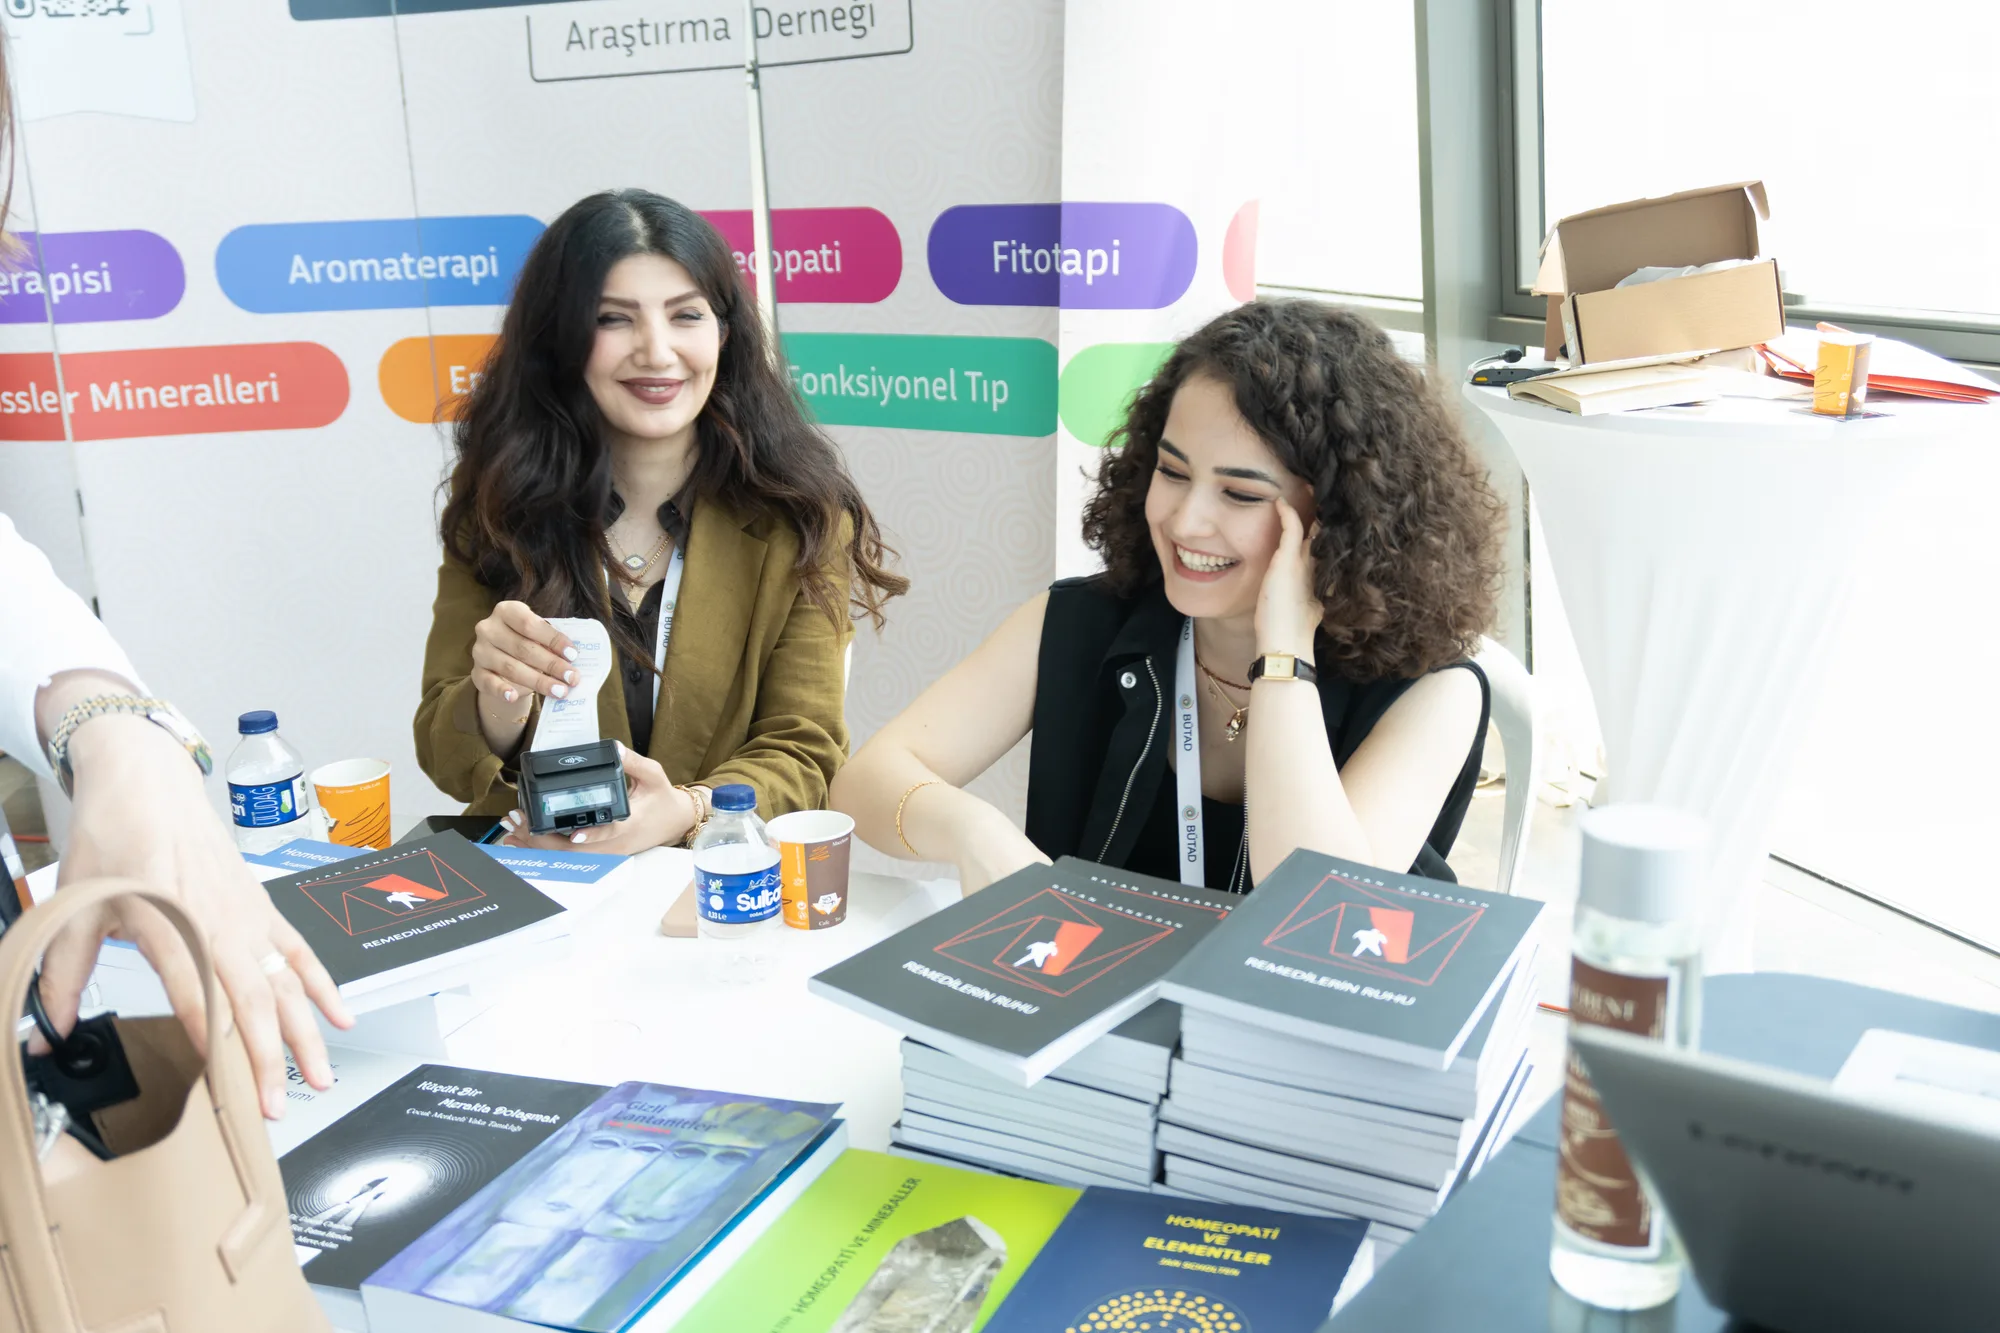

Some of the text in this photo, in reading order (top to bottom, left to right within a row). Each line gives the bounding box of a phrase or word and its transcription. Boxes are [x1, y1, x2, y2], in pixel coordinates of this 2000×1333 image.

[566, 16, 732, 57] Araştırma
[288, 246, 499, 286] Aromaterapi
[89, 372, 281, 412] Mineralleri
[964, 371, 1009, 411] Tıp
[1182, 714, 1193, 752] BÜTAD
[1186, 825, 1197, 863] BÜTAD
[548, 862, 600, 873] Sinerji
[362, 903, 500, 950] REMEDİLERİN RUHU
[992, 994, 1040, 1016] RUHU
[1360, 986, 1417, 1007] RUHU
[626, 1101, 667, 1114] Gizli
[1165, 1214, 1281, 1240] HOMEOPATİ
[1203, 1232, 1231, 1246] VE
[848, 1235, 871, 1255] VE
[1143, 1236, 1272, 1266] ELEMENTLER
